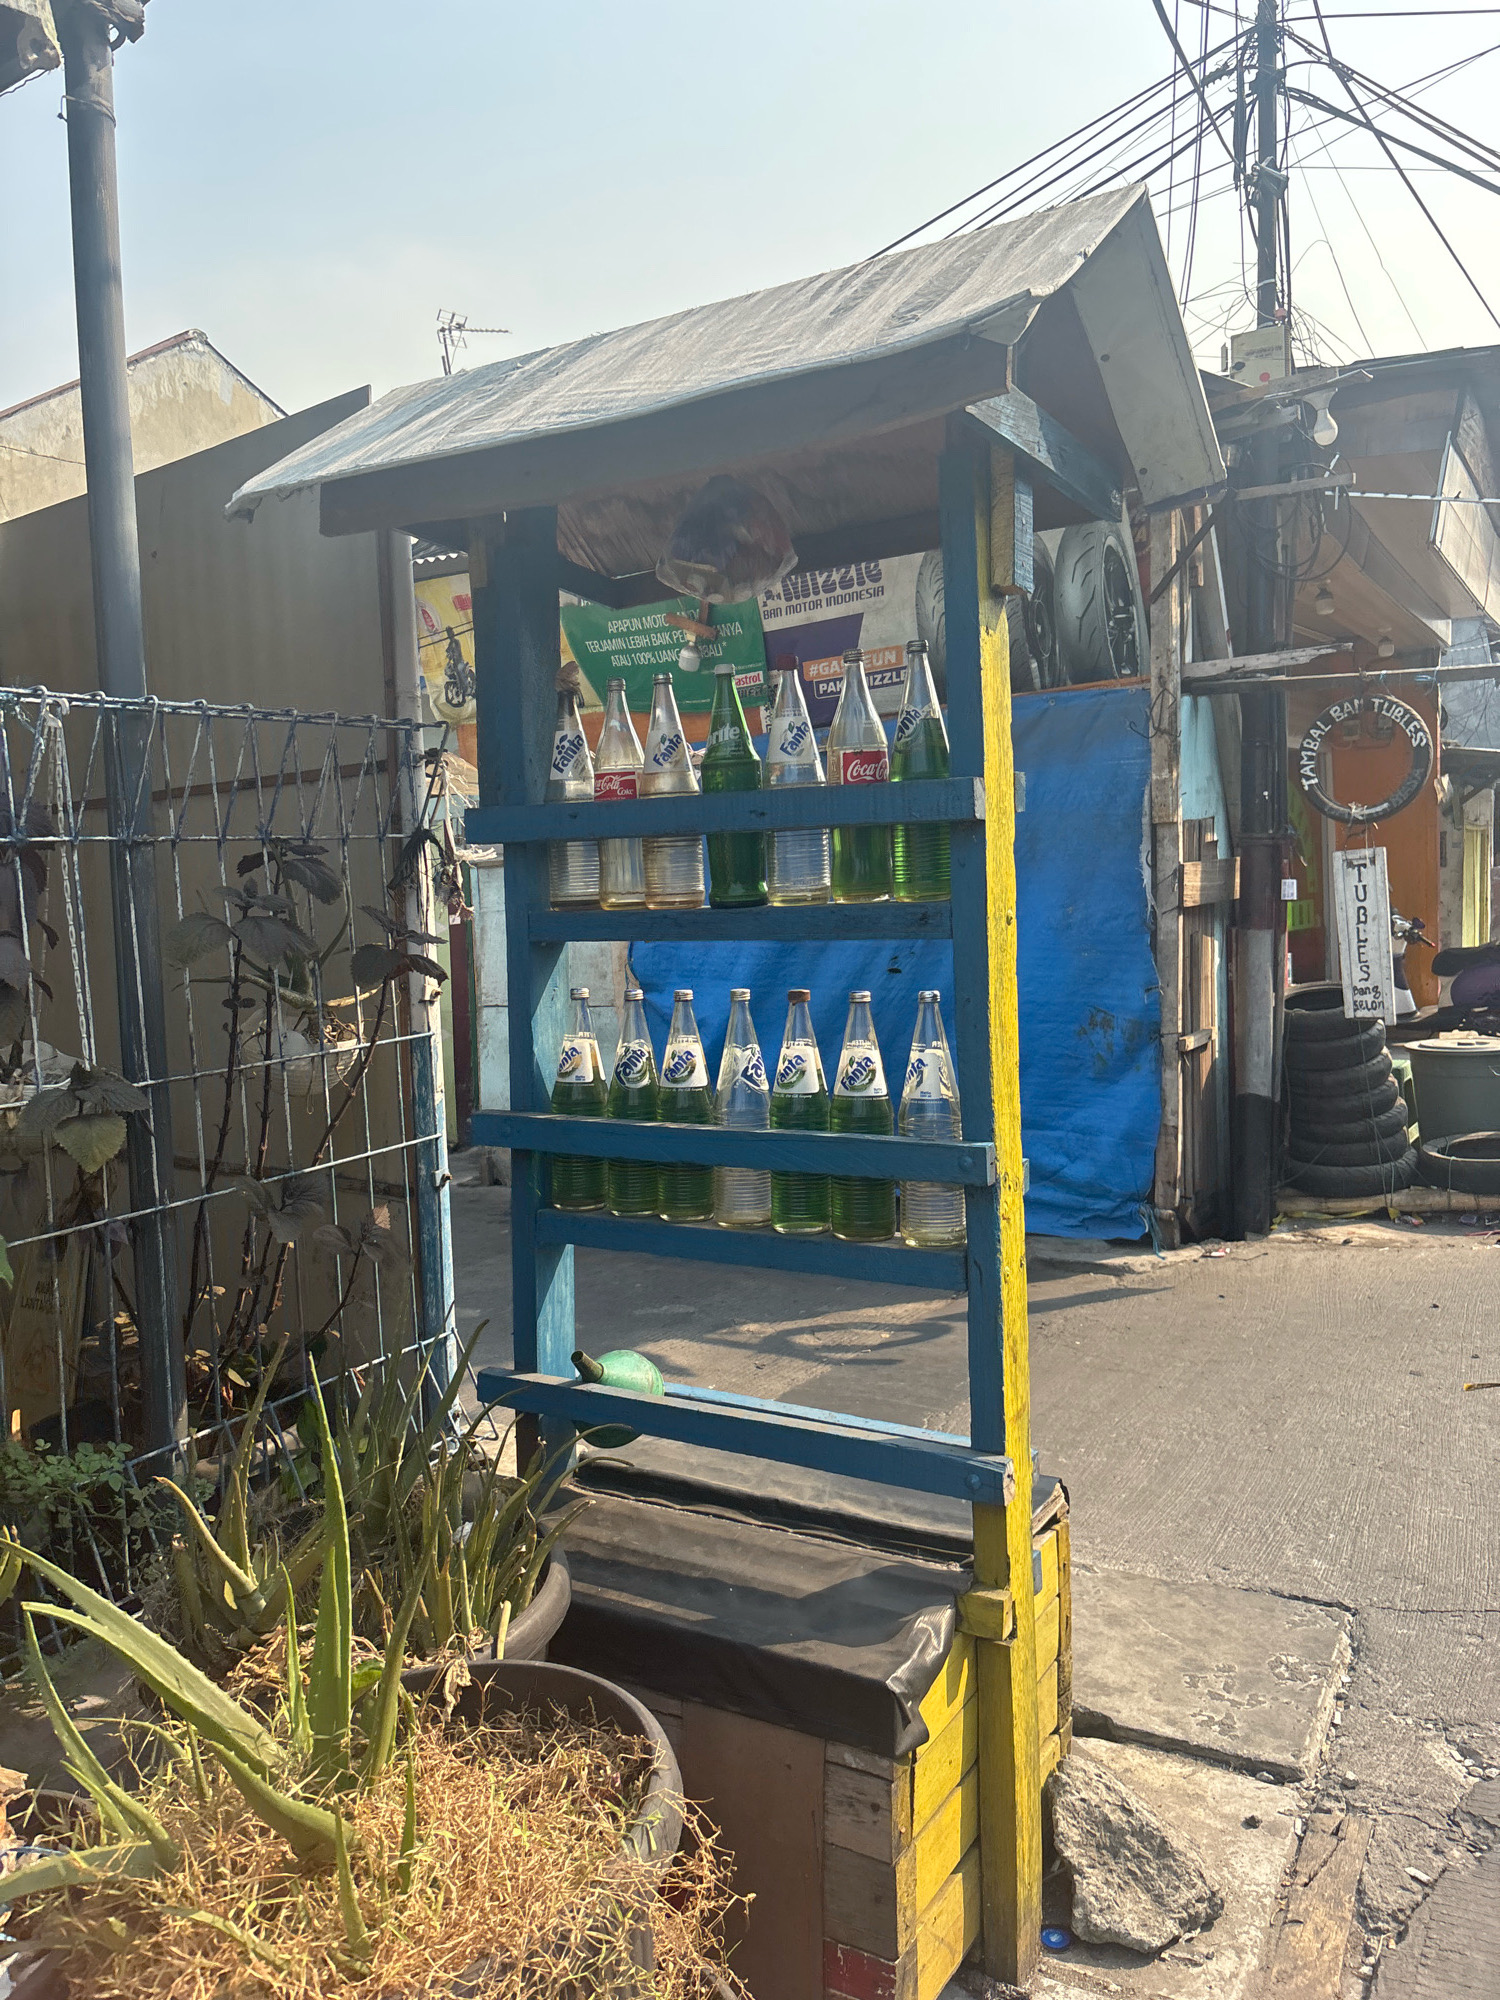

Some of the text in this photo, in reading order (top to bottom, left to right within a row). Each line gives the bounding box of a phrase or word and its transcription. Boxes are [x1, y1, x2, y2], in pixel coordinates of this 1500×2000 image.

[763, 585, 885, 620] BAN MOTOR INDONESIA
[608, 616, 643, 633] APAPUN
[644, 613, 668, 629] MOTO
[585, 634, 626, 653] TERJAMIN
[626, 631, 650, 649] LEBIH
[651, 629, 673, 647] BAIK
[611, 651, 631, 667] ATAU
[632, 649, 656, 665] 100%
[735, 672, 762, 687] astrol
[819, 669, 908, 695] PAK IZZLE
[709, 723, 740, 746] rite
[780, 720, 810, 757] Fanta
[896, 709, 922, 742] anta
[553, 734, 585, 774] Fanta
[653, 733, 683, 767] Fanta
[1300, 720, 1332, 792] TAMBAL
[1329, 698, 1364, 722] BAN
[1371, 698, 1427, 748] TUBLES
[1353, 863, 1371, 983] TUBLES
[558, 1046, 580, 1072] anta
[615, 1046, 646, 1086] Fanta
[664, 1050, 695, 1083] Fanta
[840, 1056, 874, 1091] Fanta
